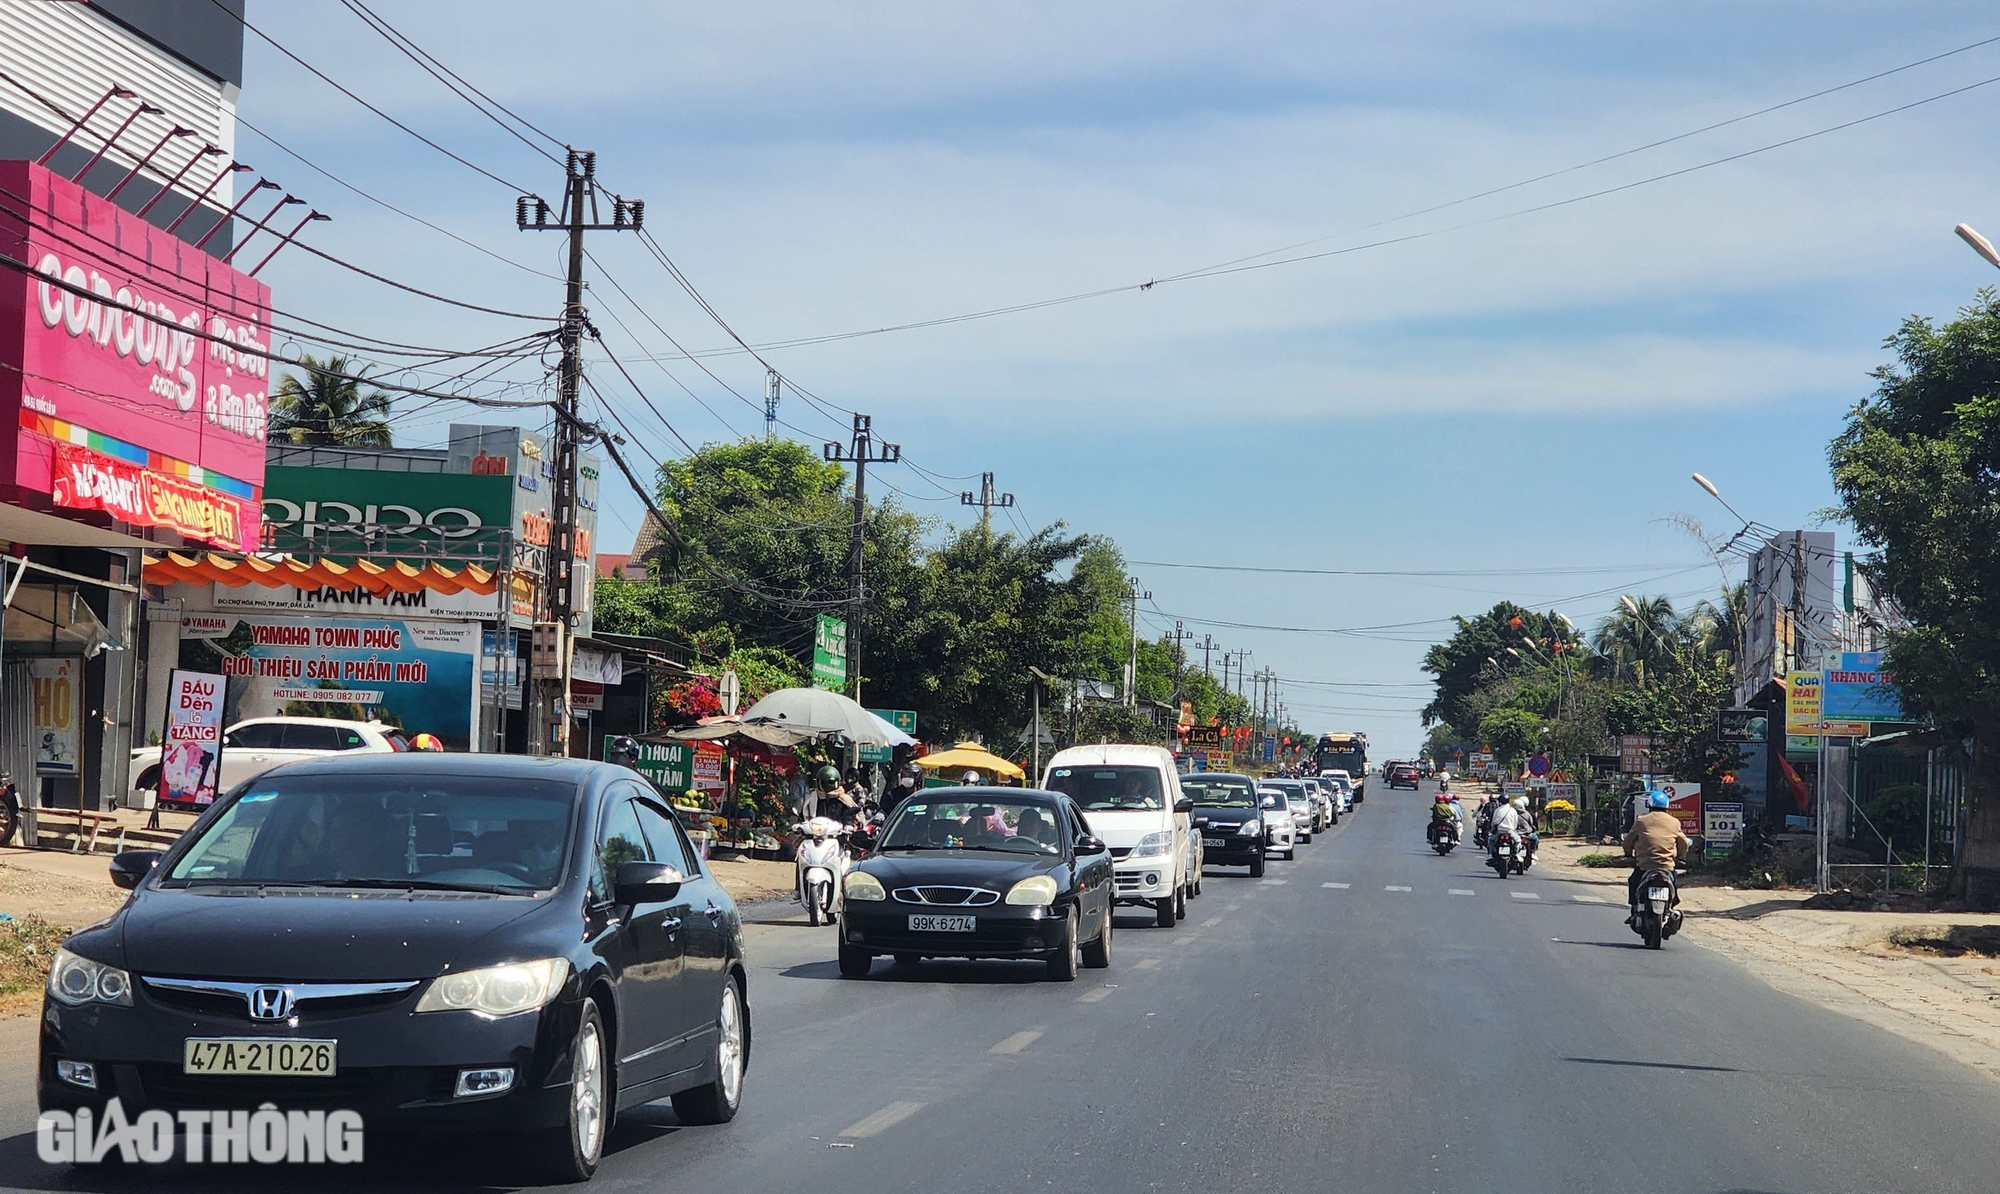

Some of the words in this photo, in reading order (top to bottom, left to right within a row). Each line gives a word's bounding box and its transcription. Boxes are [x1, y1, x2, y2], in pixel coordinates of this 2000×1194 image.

[38, 253, 200, 412] concung
[219, 384, 244, 435] Em
[191, 617, 227, 629] YAMAHA
[251, 624, 311, 647] YAMAHA
[314, 627, 360, 648] TOWN
[363, 624, 401, 649] PHÚC
[438, 628, 465, 637] Discover
[221, 653, 254, 677] GIỚI
[258, 655, 302, 682] THIỆU
[306, 654, 340, 681] SẢN
[344, 653, 391, 682] PHẨM
[395, 657, 428, 684] MỚI
[1830, 671, 1876, 683] KHANG
[273, 688, 310, 699] HOTLINE:
[312, 691, 334, 700] 0905
[336, 691, 352, 701] 082
[354, 692, 371, 701] 077
[180, 695, 213, 712] Đến
[656, 766, 683, 788] TÂM
[1709, 821, 1738, 831] 101
[912, 917, 972, 931] 99K-6274
[190, 1042, 330, 1072] 47A-210.26
